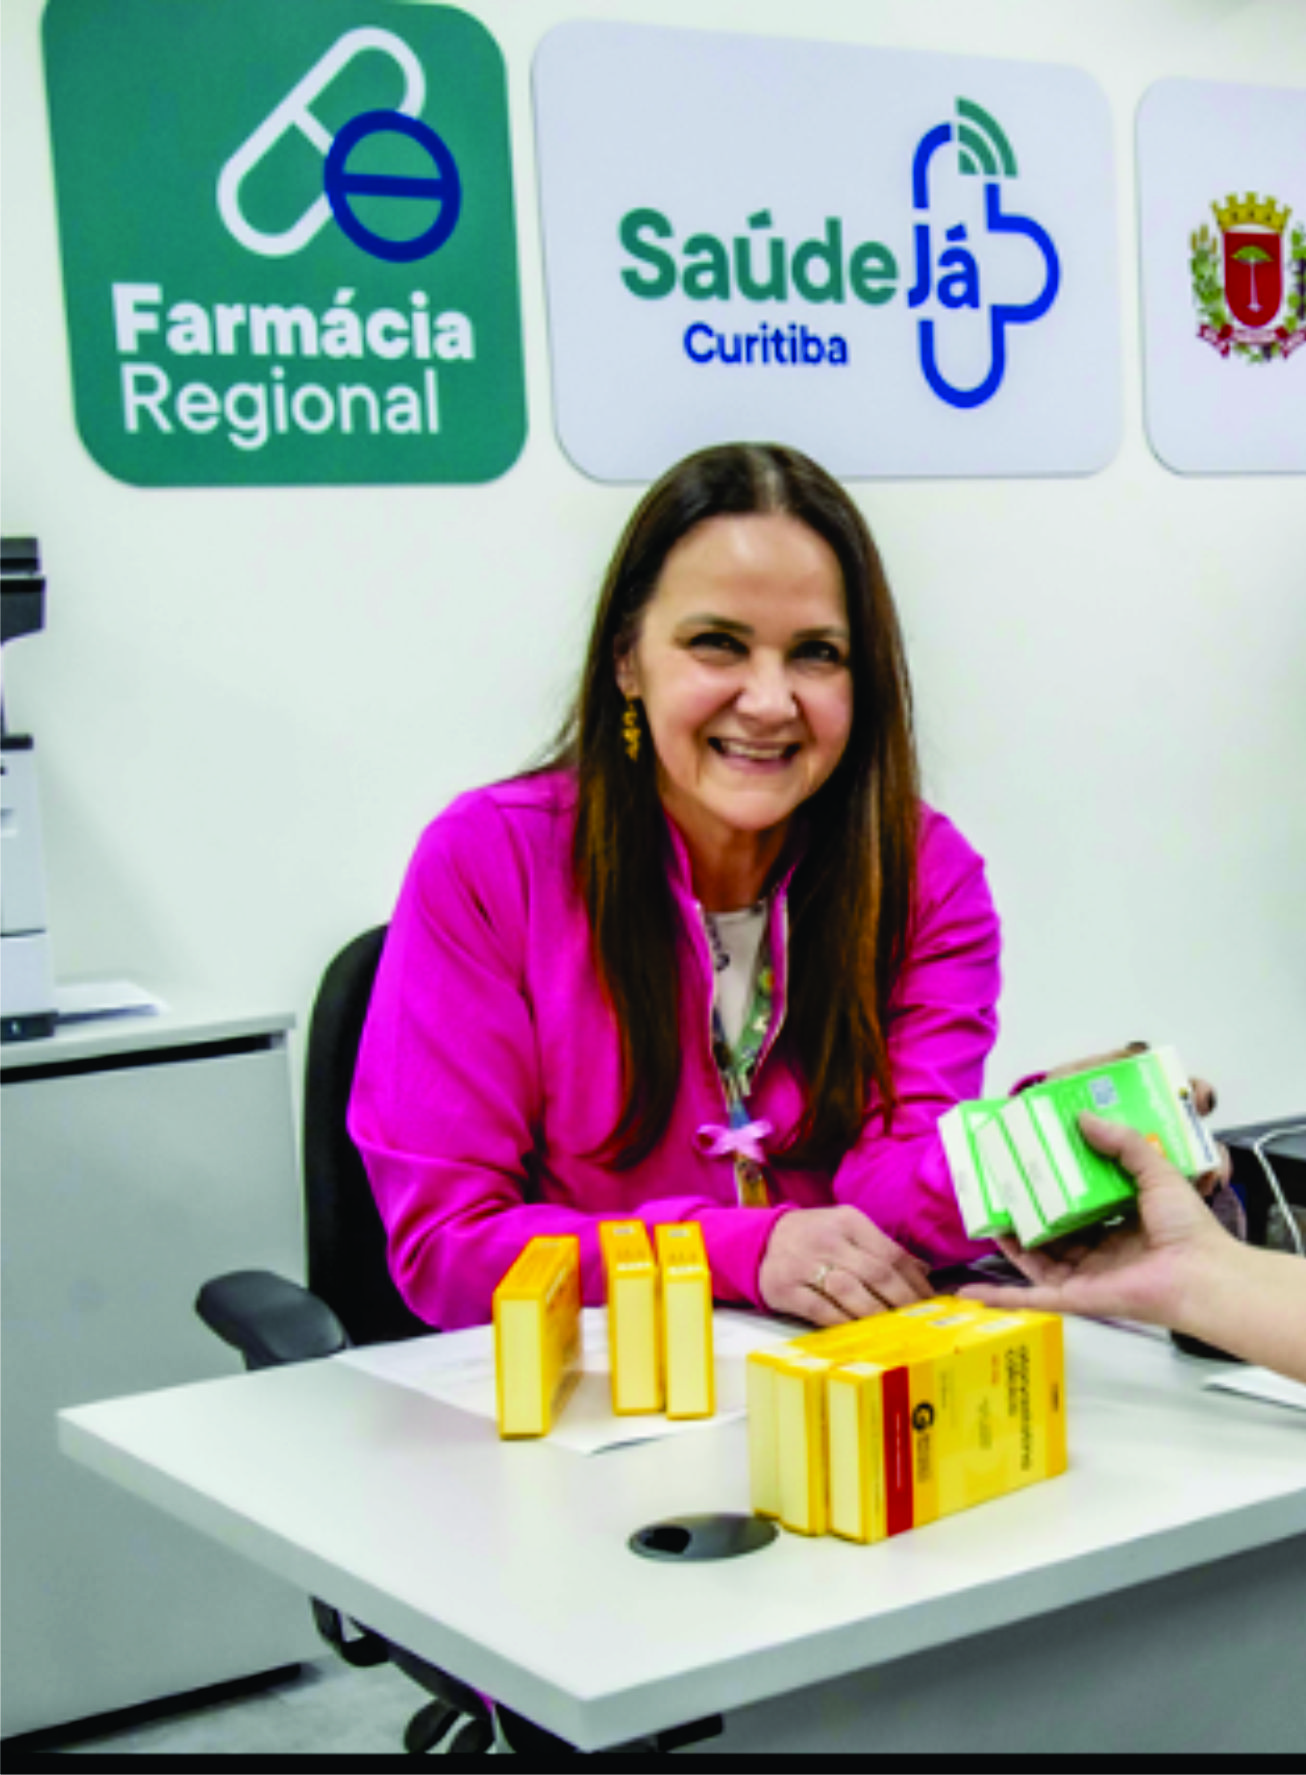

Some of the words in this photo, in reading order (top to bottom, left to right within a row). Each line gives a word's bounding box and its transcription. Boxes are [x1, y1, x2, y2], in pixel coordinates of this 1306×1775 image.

[618, 207, 899, 307] Saúde
[906, 223, 981, 310] Já
[112, 283, 474, 360] Farmácia
[682, 320, 849, 367] Curitiba
[121, 362, 440, 450] Regional
